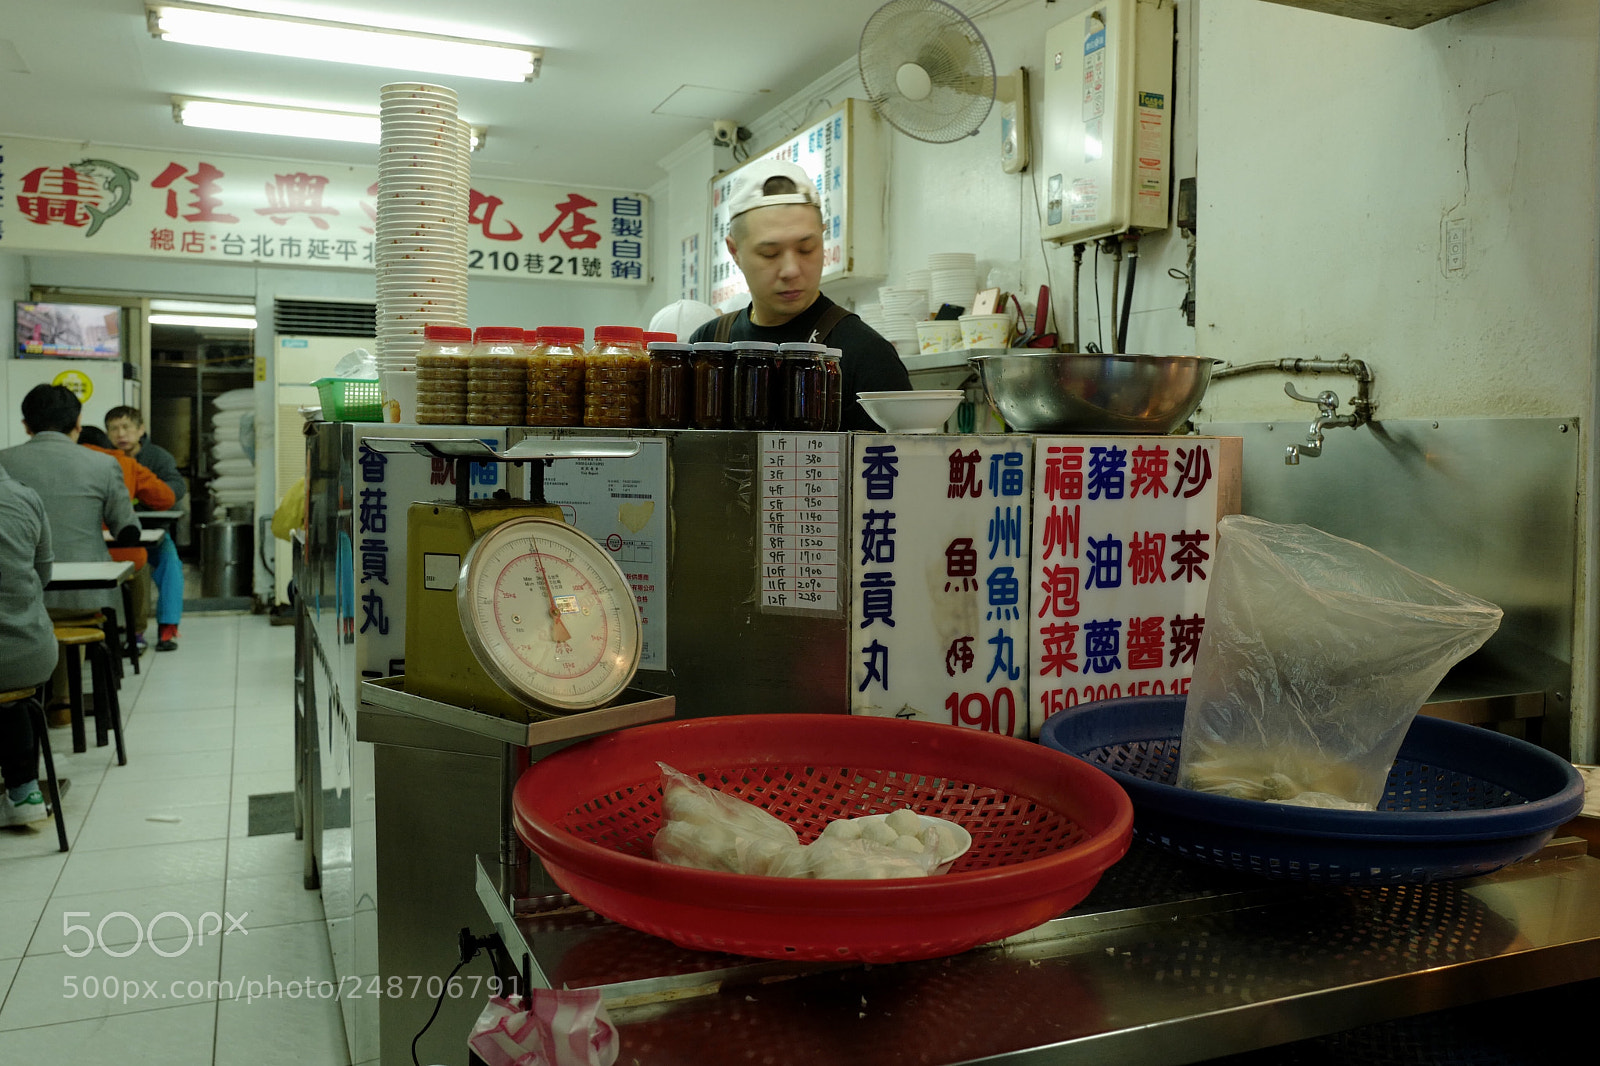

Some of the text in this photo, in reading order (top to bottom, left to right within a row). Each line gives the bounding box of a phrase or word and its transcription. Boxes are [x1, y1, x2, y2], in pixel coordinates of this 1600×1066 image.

[808, 440, 823, 449] 190
[805, 454, 821, 464] 380
[805, 469, 822, 478] 570
[805, 483, 822, 493] 760
[804, 498, 822, 508] 950
[800, 512, 822, 522] 1140
[800, 525, 822, 534] 1330
[800, 537, 823, 547] 1520
[800, 551, 821, 561] 1710
[1038, 444, 1084, 678] 福州泡菜
[1126, 444, 1170, 670] 辣椒醬
[800, 566, 822, 577] 1900
[859, 445, 899, 692] 香菇貢丸
[986, 452, 1024, 683] 福州魚丸
[797, 579, 821, 589] 2090
[798, 592, 822, 602] 2280
[945, 687, 1016, 738] 190
